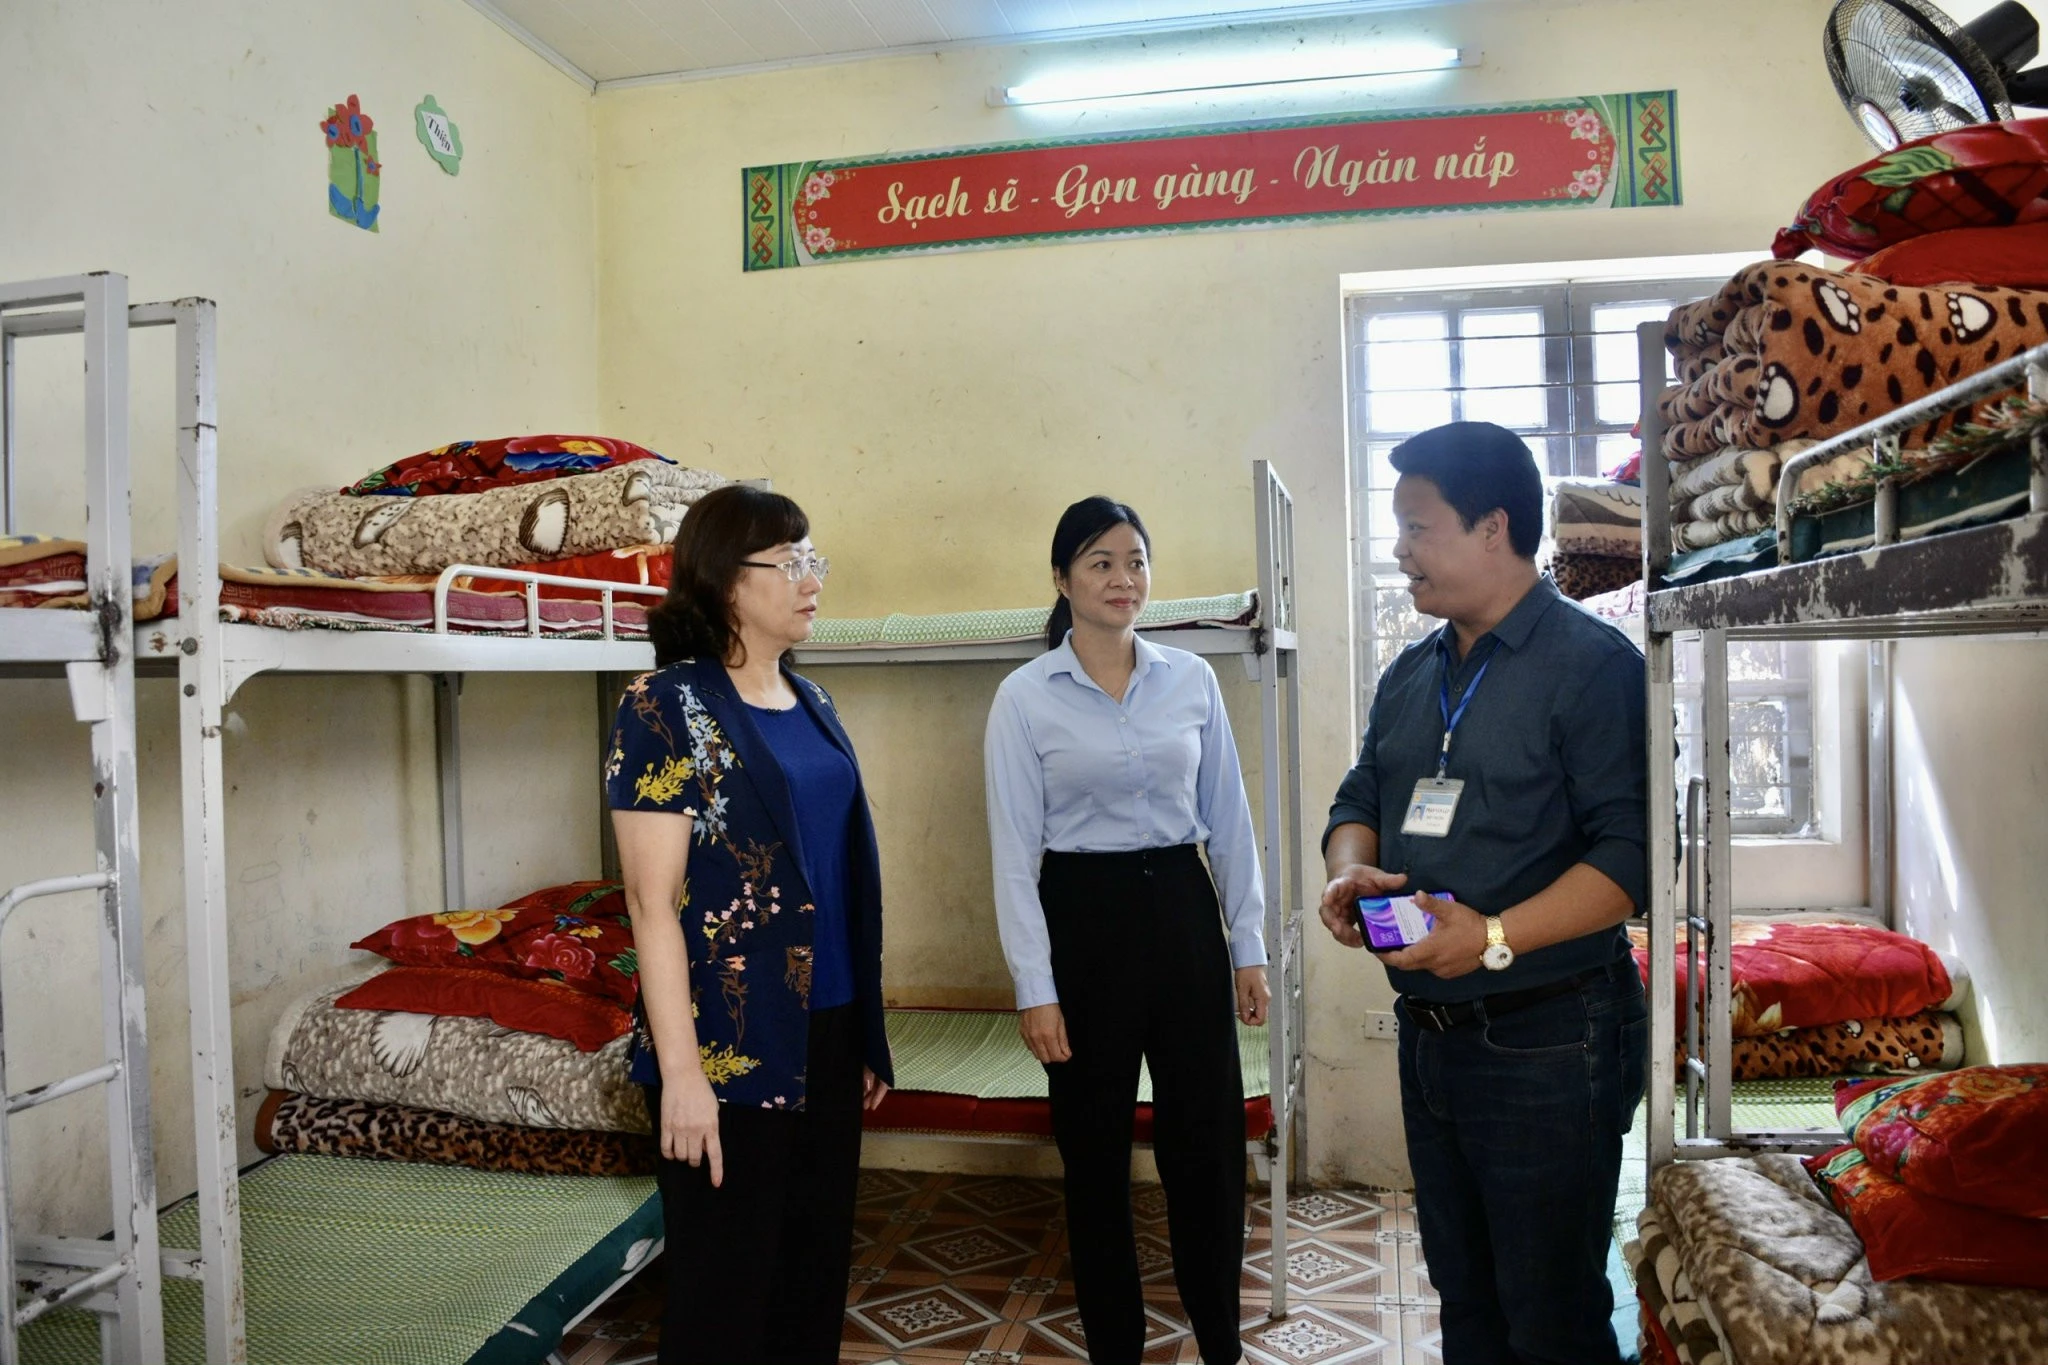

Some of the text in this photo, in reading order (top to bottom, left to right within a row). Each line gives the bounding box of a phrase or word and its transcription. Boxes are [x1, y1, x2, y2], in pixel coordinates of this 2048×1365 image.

[878, 176, 973, 229] Sạch
[984, 178, 1019, 214] sẽ
[1051, 164, 1140, 218] Gọn
[1153, 163, 1258, 210] gàng
[1293, 144, 1420, 196] Ngăn
[1434, 136, 1519, 188] nắp
